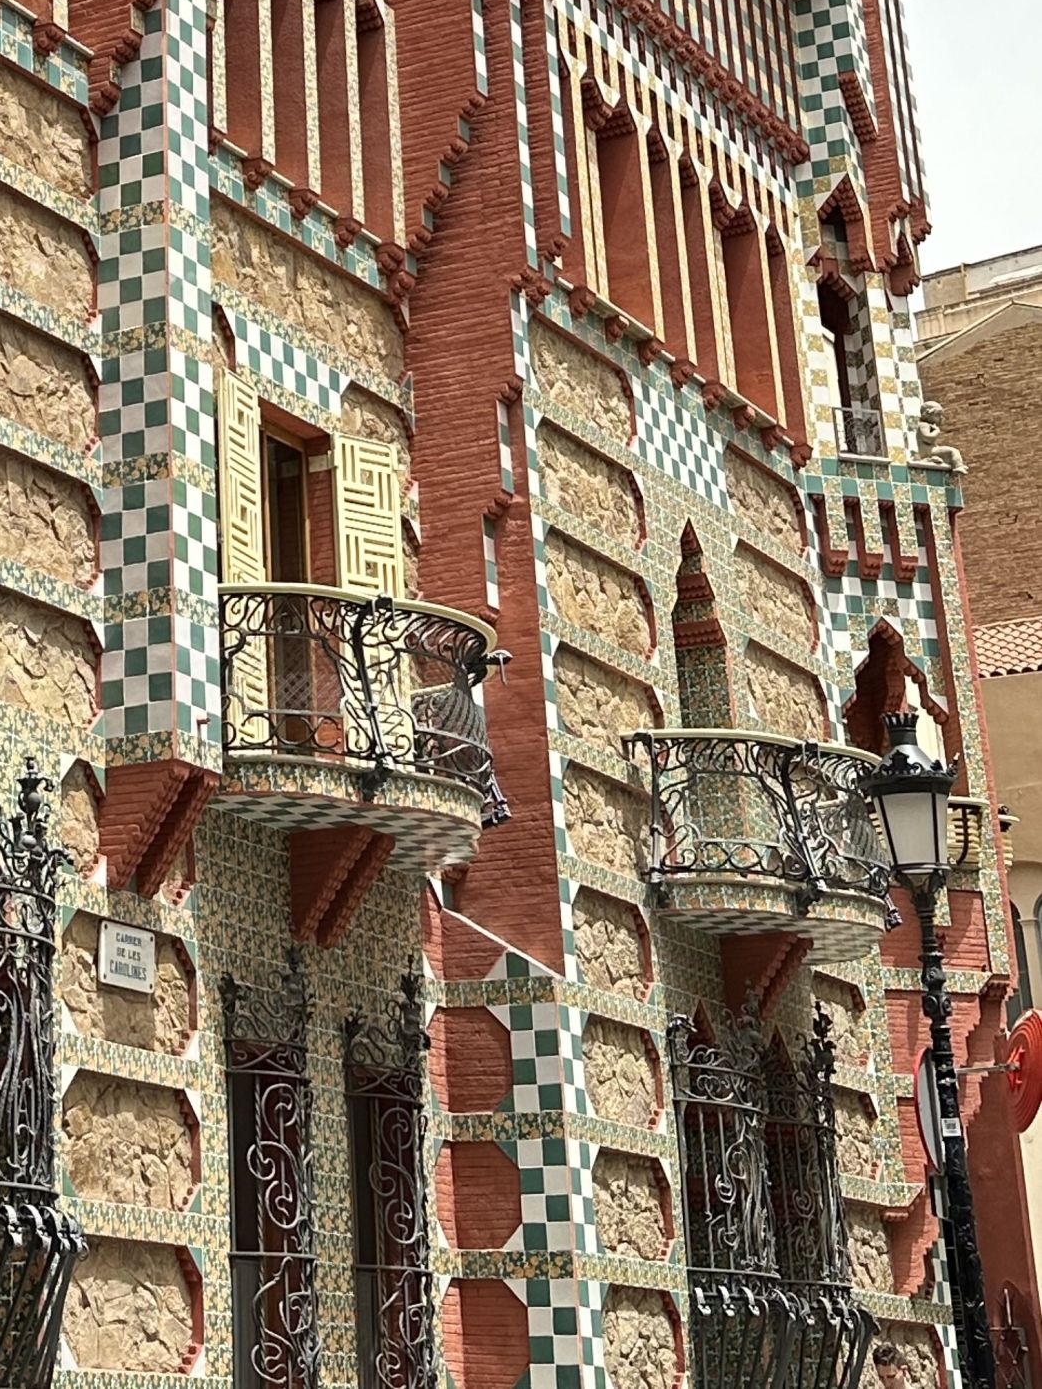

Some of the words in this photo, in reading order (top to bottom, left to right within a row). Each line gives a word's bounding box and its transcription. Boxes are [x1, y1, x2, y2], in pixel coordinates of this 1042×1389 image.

[116, 932, 142, 947] CARRER
[116, 947, 126, 958] DE
[128, 949, 141, 961] LES
[109, 959, 147, 981] CAROLINES
